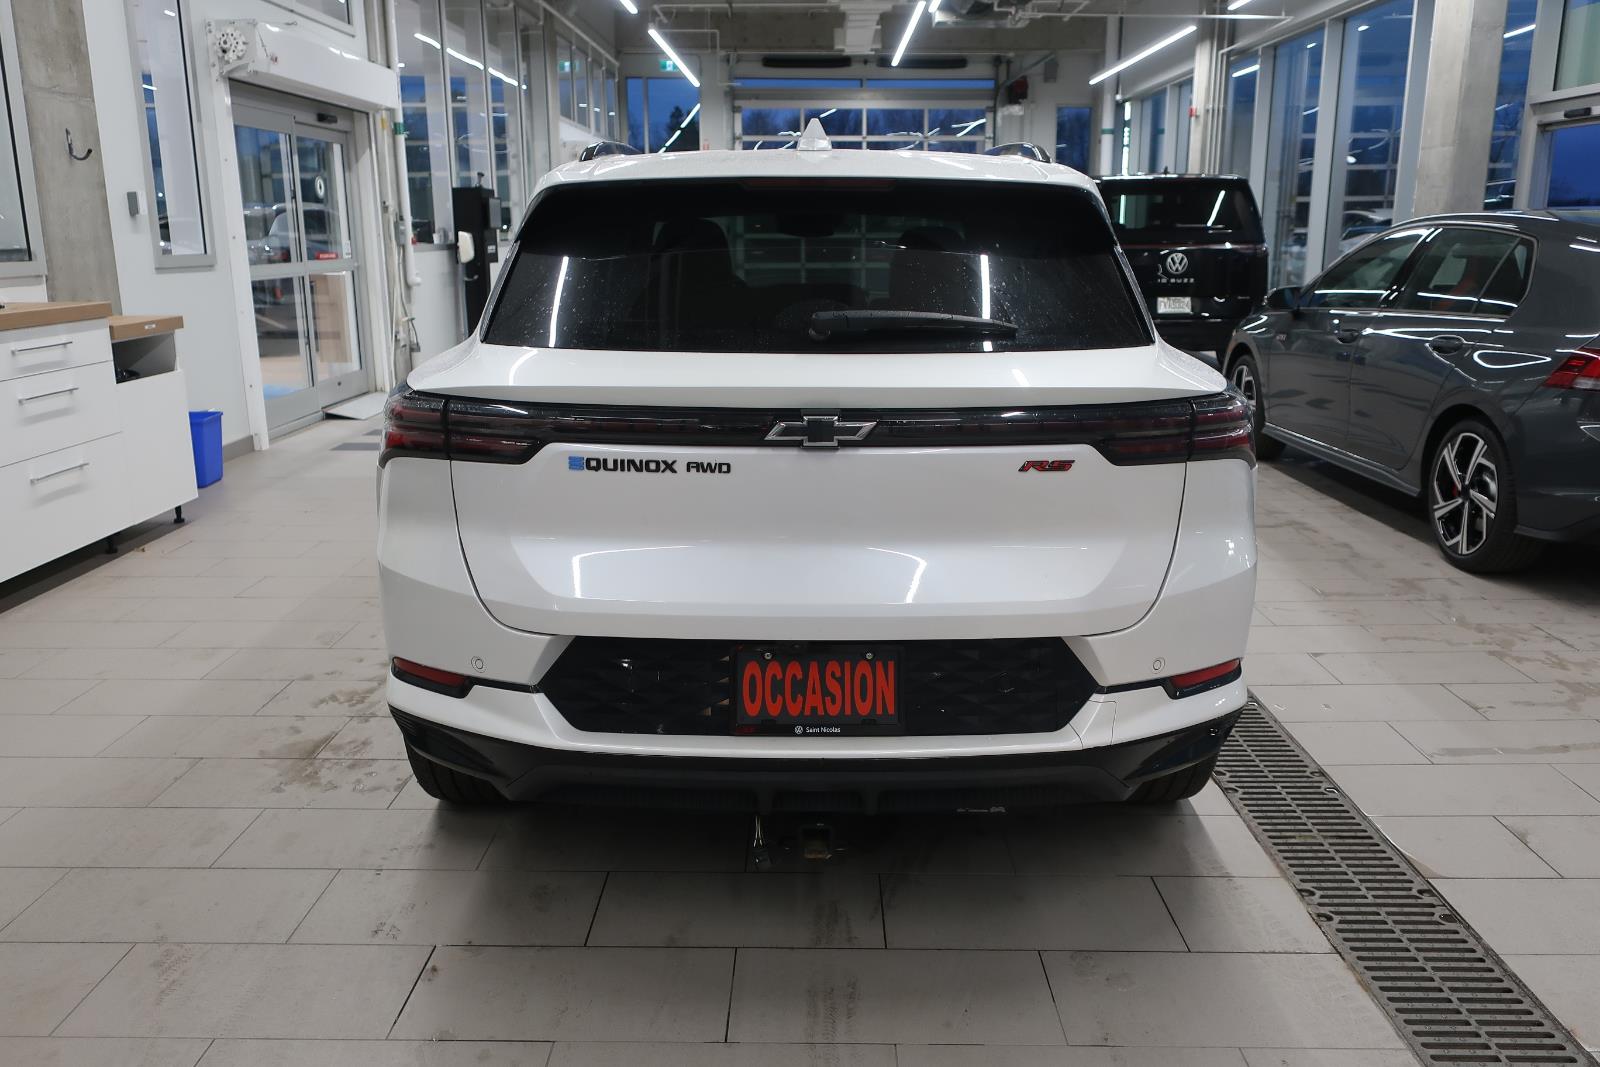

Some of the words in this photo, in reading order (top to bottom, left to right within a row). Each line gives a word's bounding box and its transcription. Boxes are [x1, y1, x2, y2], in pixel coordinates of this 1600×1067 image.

[686, 461, 731, 474] AWD
[1018, 459, 1076, 472] RS
[742, 660, 895, 717] OCCASION
[806, 726, 820, 734] Saint
[821, 726, 841, 734] Nicolas
